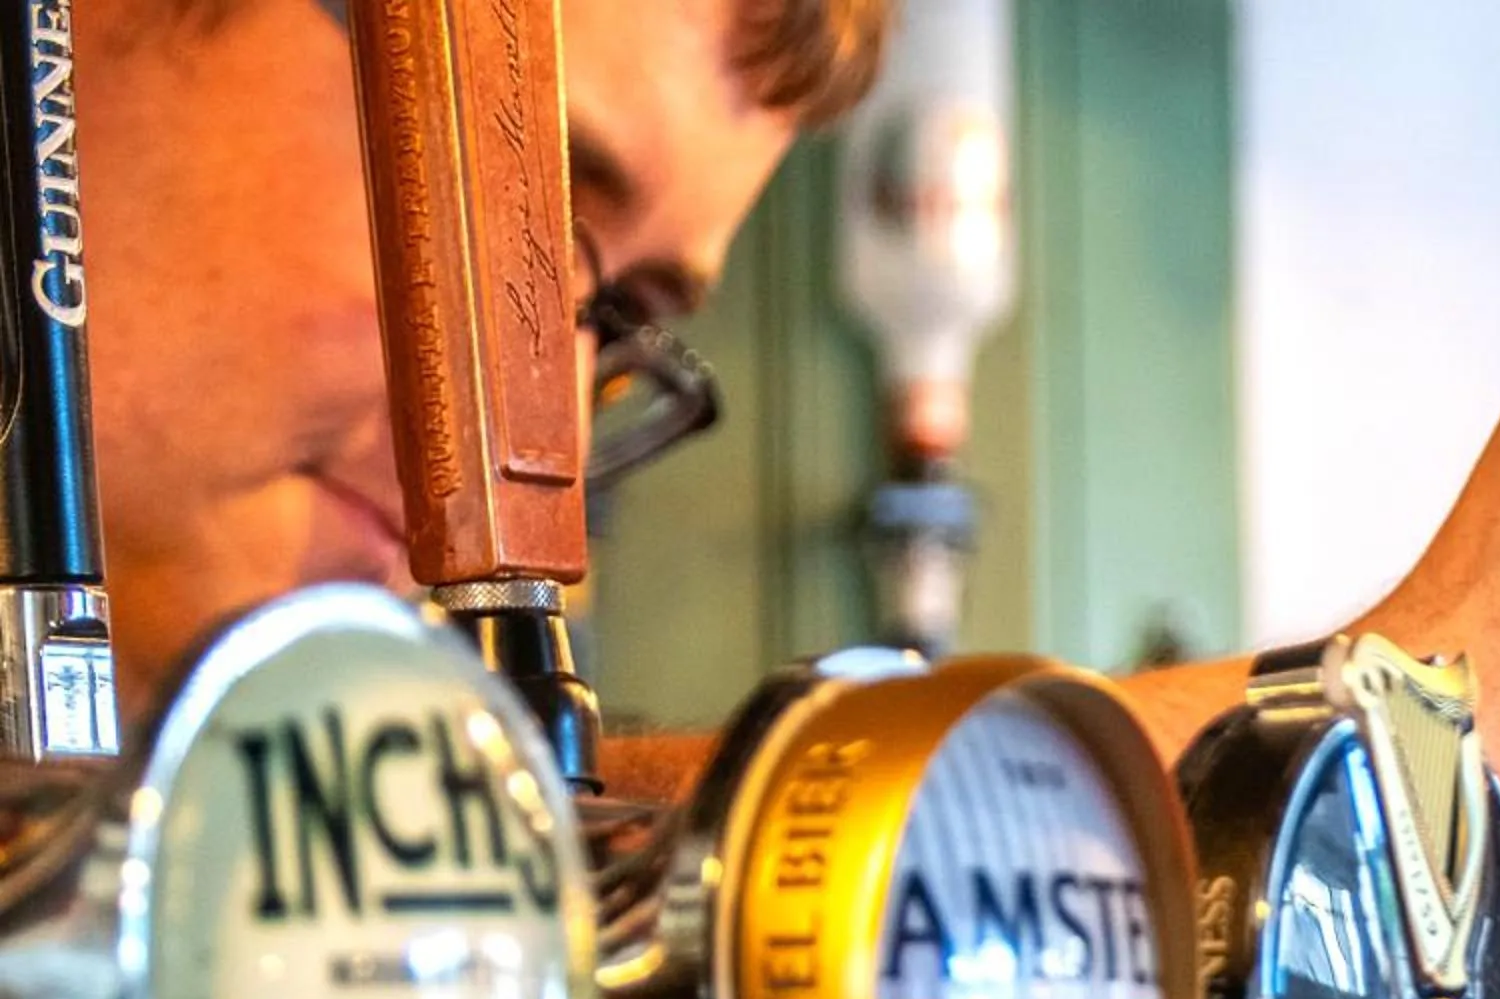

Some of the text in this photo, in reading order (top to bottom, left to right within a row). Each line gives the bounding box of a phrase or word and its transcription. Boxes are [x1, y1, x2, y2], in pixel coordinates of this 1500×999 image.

[32, 0, 86, 328] GUINNE
[776, 739, 873, 888] BIER
[880, 867, 1153, 986] AMSTE
